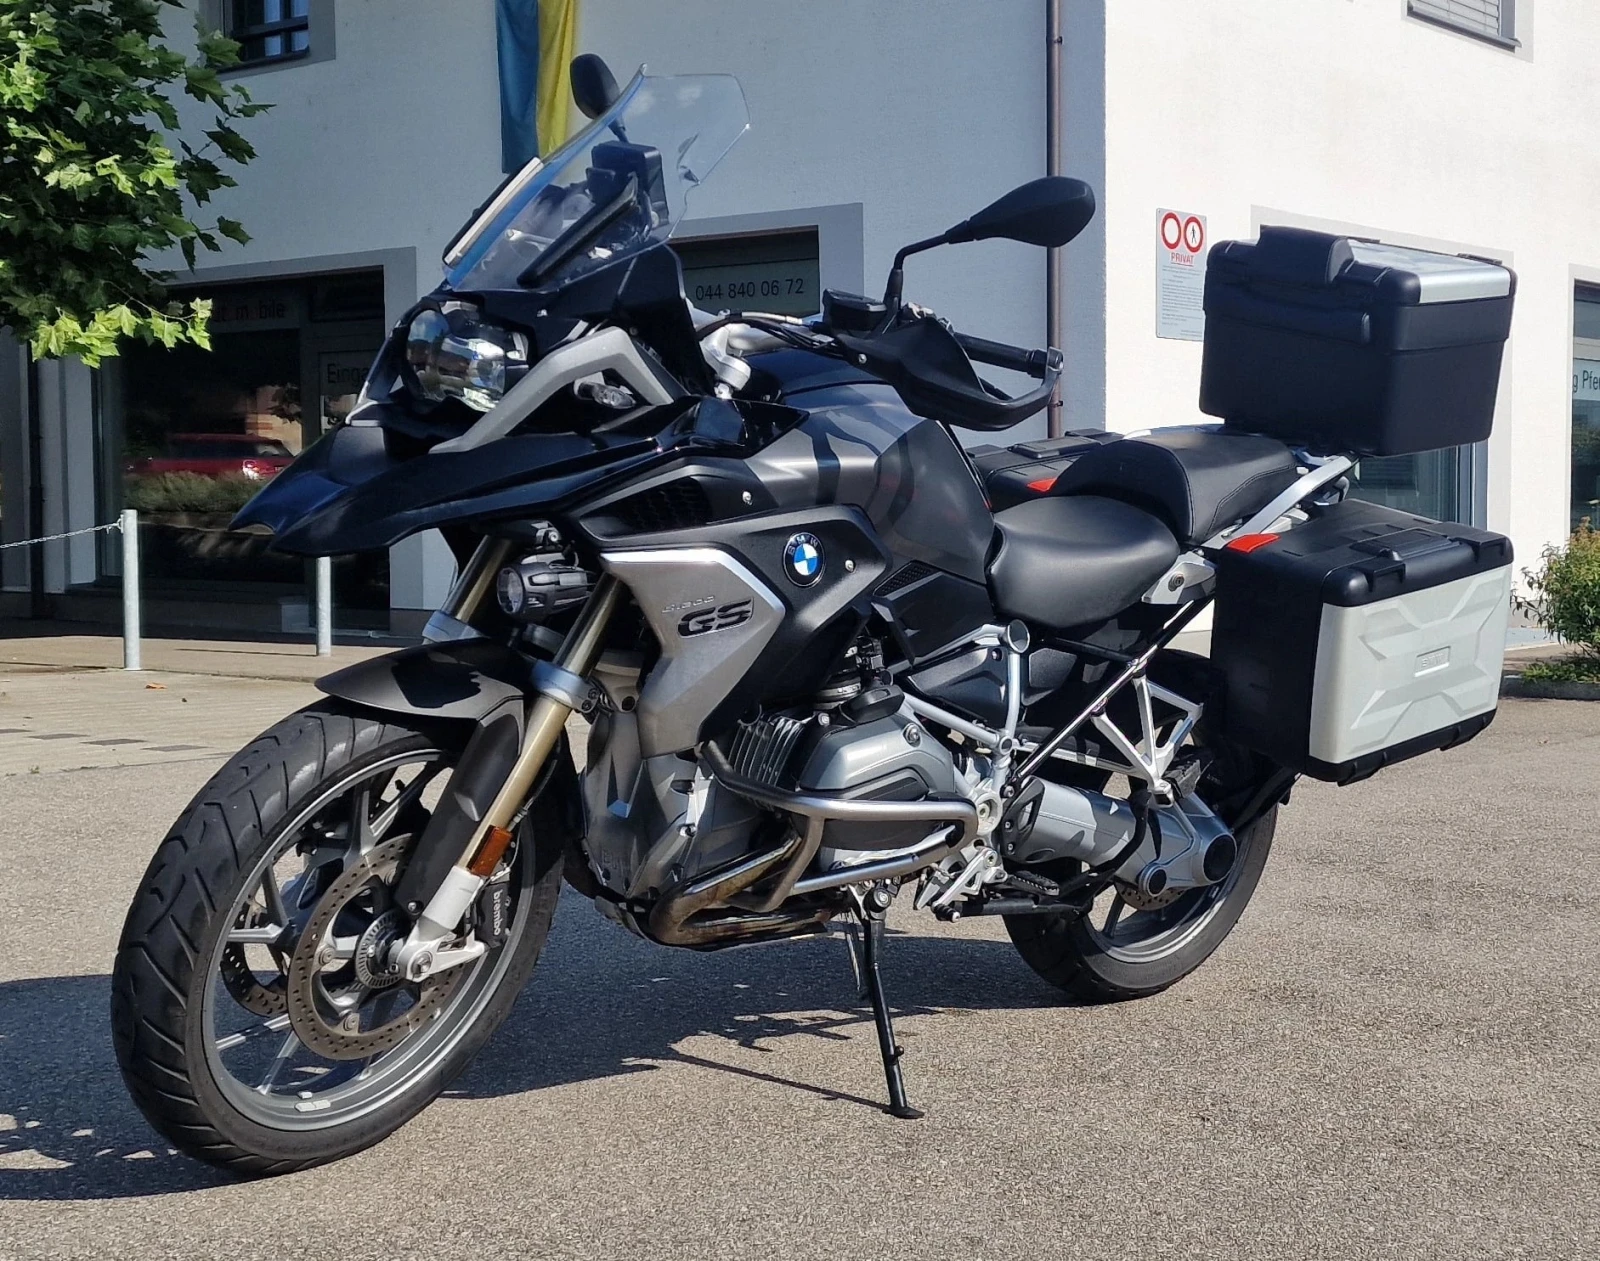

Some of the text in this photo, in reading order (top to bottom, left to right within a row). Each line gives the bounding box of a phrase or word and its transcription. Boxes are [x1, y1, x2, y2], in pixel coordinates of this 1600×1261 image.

[1171, 252, 1194, 264] PRIVAT
[695, 278, 804, 300] 044 840 06 72
[327, 363, 369, 387] Einga
[1582, 370, 1600, 390] Pfe
[677, 598, 753, 637] GS
[493, 889, 503, 936] brembo
